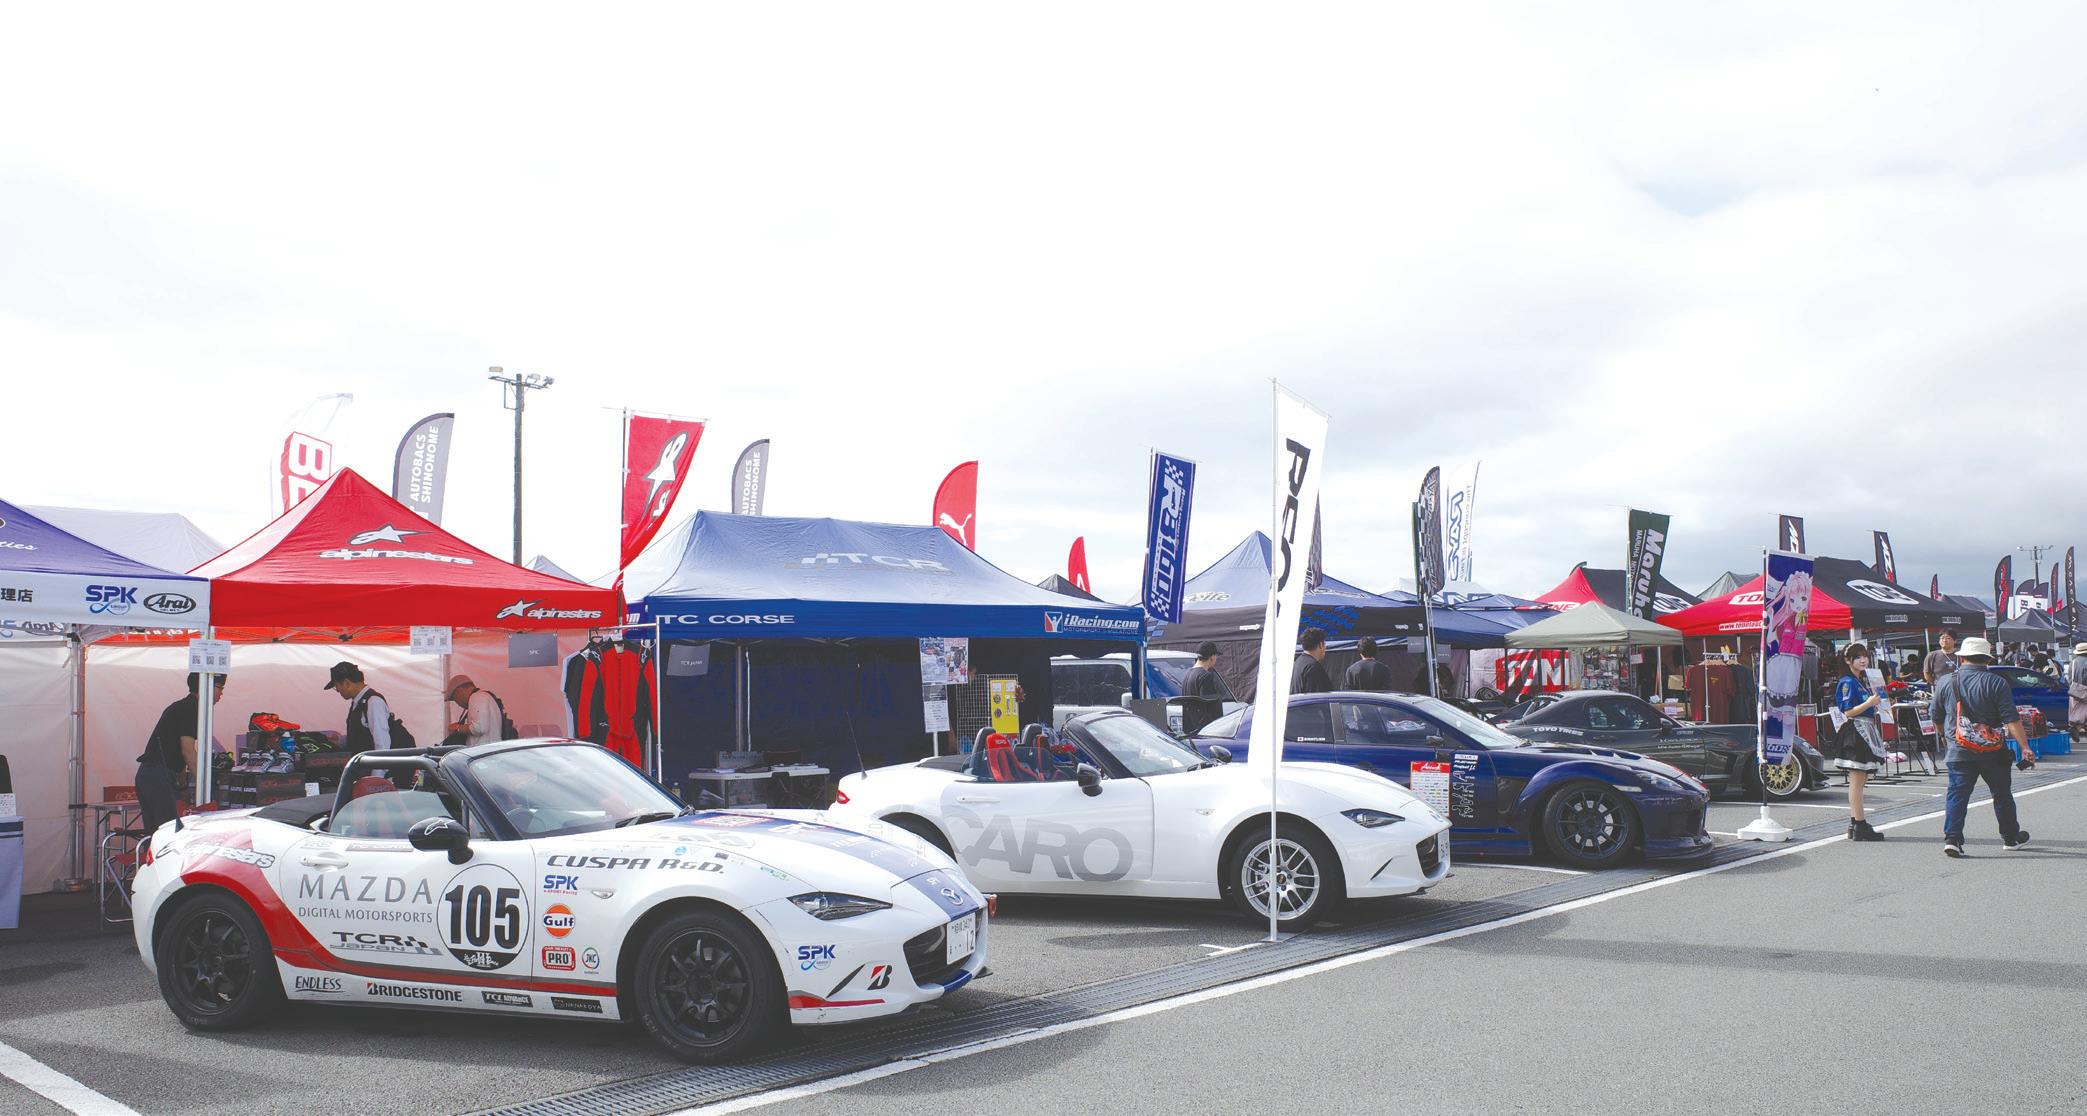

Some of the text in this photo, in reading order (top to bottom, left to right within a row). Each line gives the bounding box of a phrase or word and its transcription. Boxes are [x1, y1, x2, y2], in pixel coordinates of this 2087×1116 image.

[410, 434, 427, 502] AUTOBACS
[421, 425, 439, 503] SHINONOME
[320, 549, 474, 566] alpinestars
[831, 552, 950, 572] TCR
[86, 584, 138, 604] SPK
[152, 594, 190, 610] Arai
[527, 607, 603, 619] alpinestars
[708, 614, 795, 625] CORSE
[1063, 614, 1140, 629] iRacing.com
[546, 854, 725, 874] CUSPA R&D.
[299, 874, 433, 904] MAZDA
[543, 875, 579, 890] SPK
[298, 907, 433, 923] DIGITAL MOTORSPORTS
[445, 885, 520, 949] 105
[543, 915, 575, 927] Gulf
[332, 931, 401, 946] TCR
[547, 952, 570, 965] PRO
[798, 944, 836, 960] SPK
[295, 975, 342, 990] ENDLESS
[367, 982, 463, 1002] BRIDGESTONE
